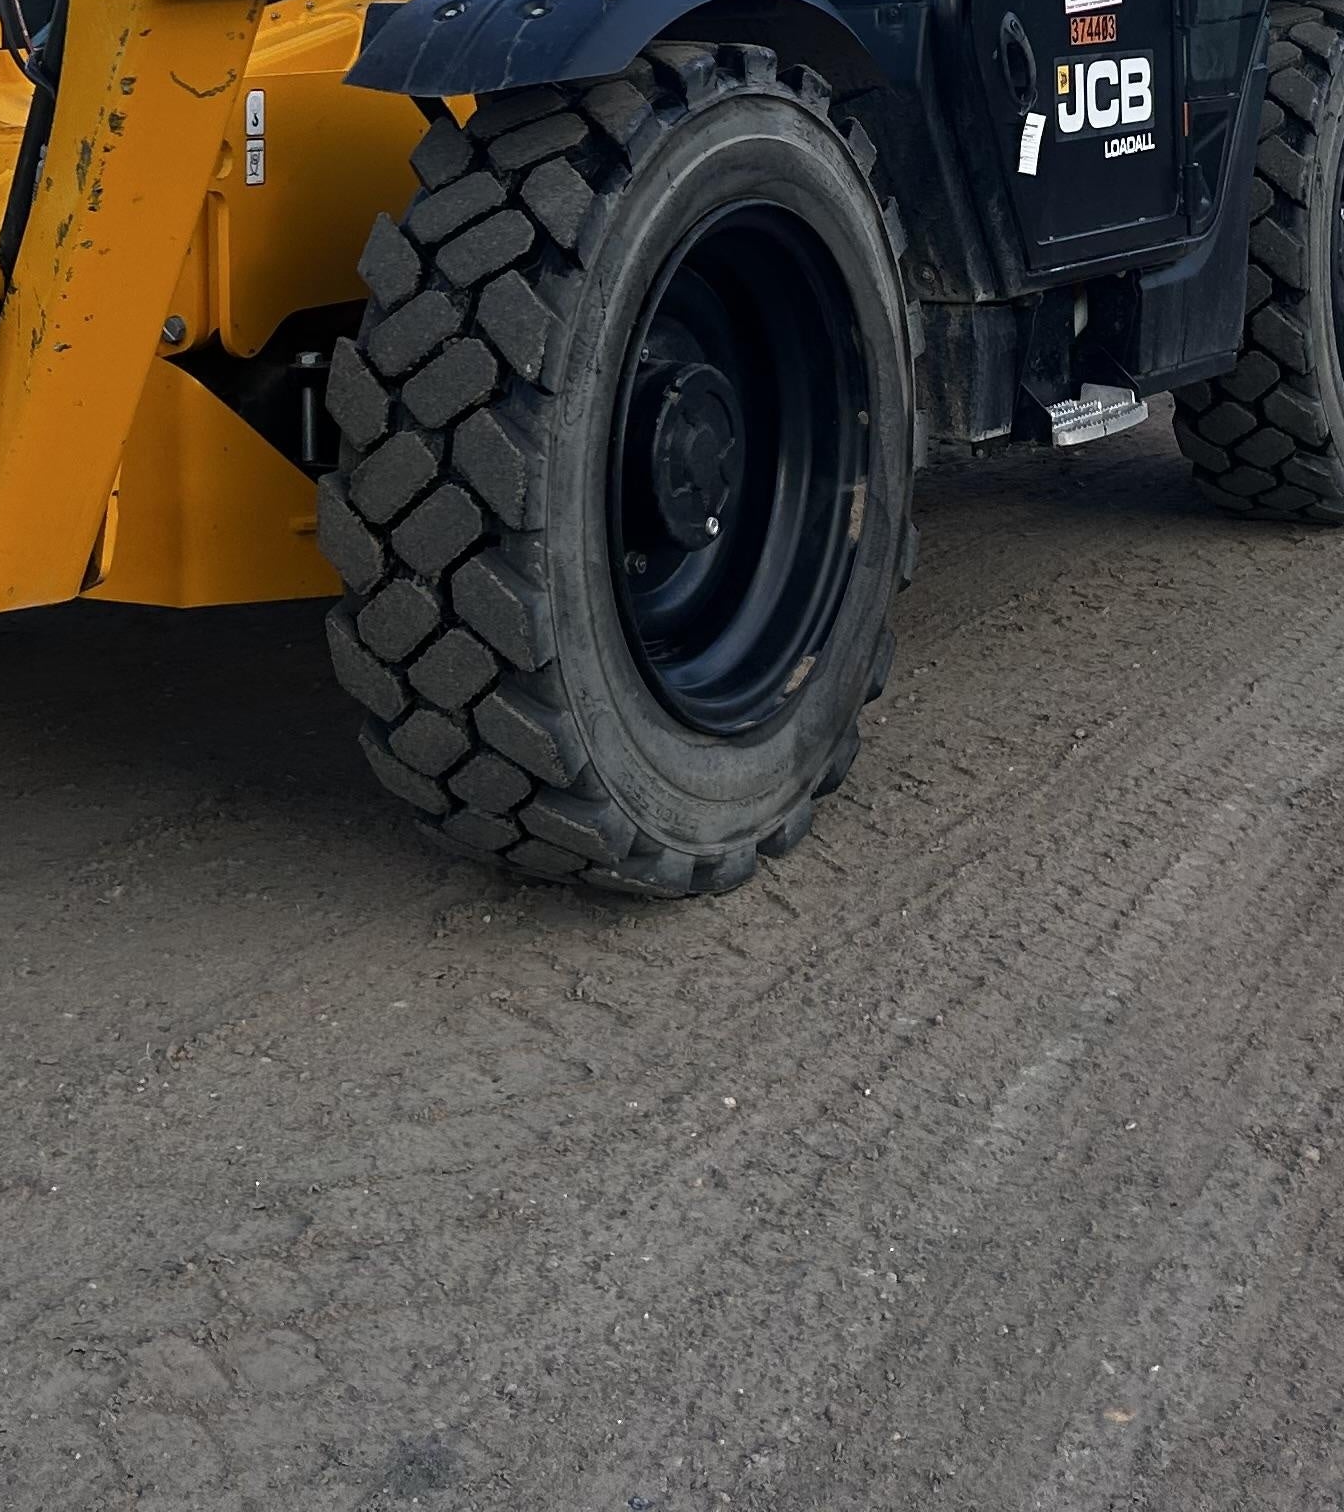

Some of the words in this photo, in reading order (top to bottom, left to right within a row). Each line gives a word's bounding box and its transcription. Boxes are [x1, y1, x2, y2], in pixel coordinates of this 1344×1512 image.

[1072, 16, 1115, 43] 374403
[1058, 57, 1152, 133] JCB
[1105, 133, 1155, 158] LOADALL
